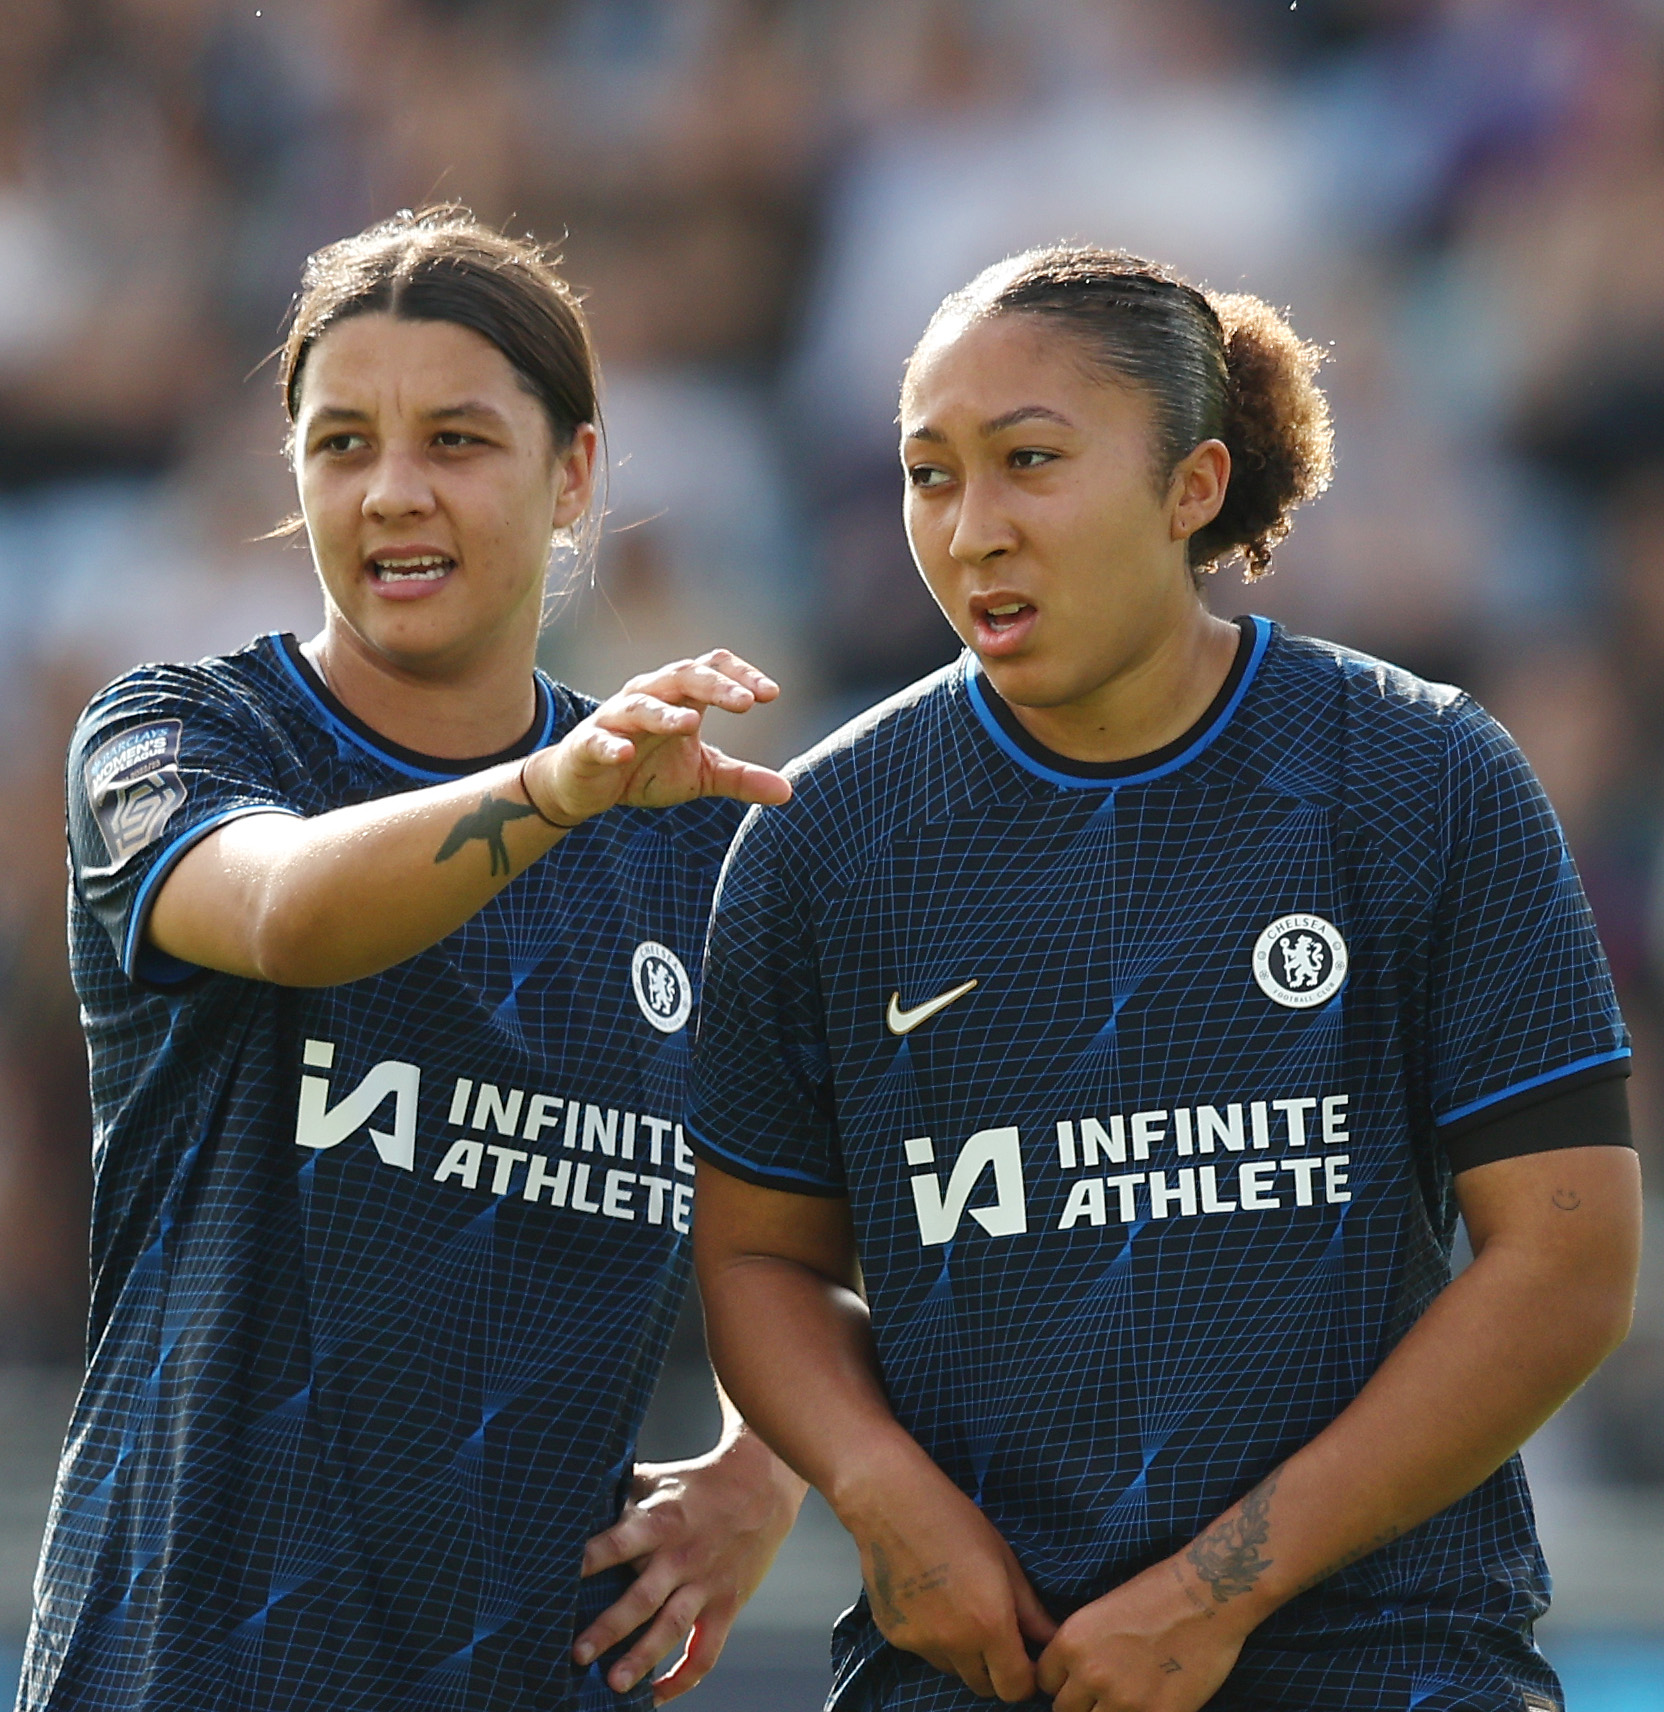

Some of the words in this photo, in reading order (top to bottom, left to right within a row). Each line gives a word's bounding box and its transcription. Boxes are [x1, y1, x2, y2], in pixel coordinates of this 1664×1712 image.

[640, 945, 679, 970] CHELSEA
[1267, 917, 1327, 939] CHELSEA
[1273, 988, 1313, 1003] FOOTBALL
[1317, 982, 1335, 998] CLUB
[448, 1077, 697, 1175] INFINITE
[1056, 1094, 1350, 1169] INFINITE
[433, 1139, 695, 1235] ATHLETE
[1057, 1155, 1352, 1230] ATHLETE
